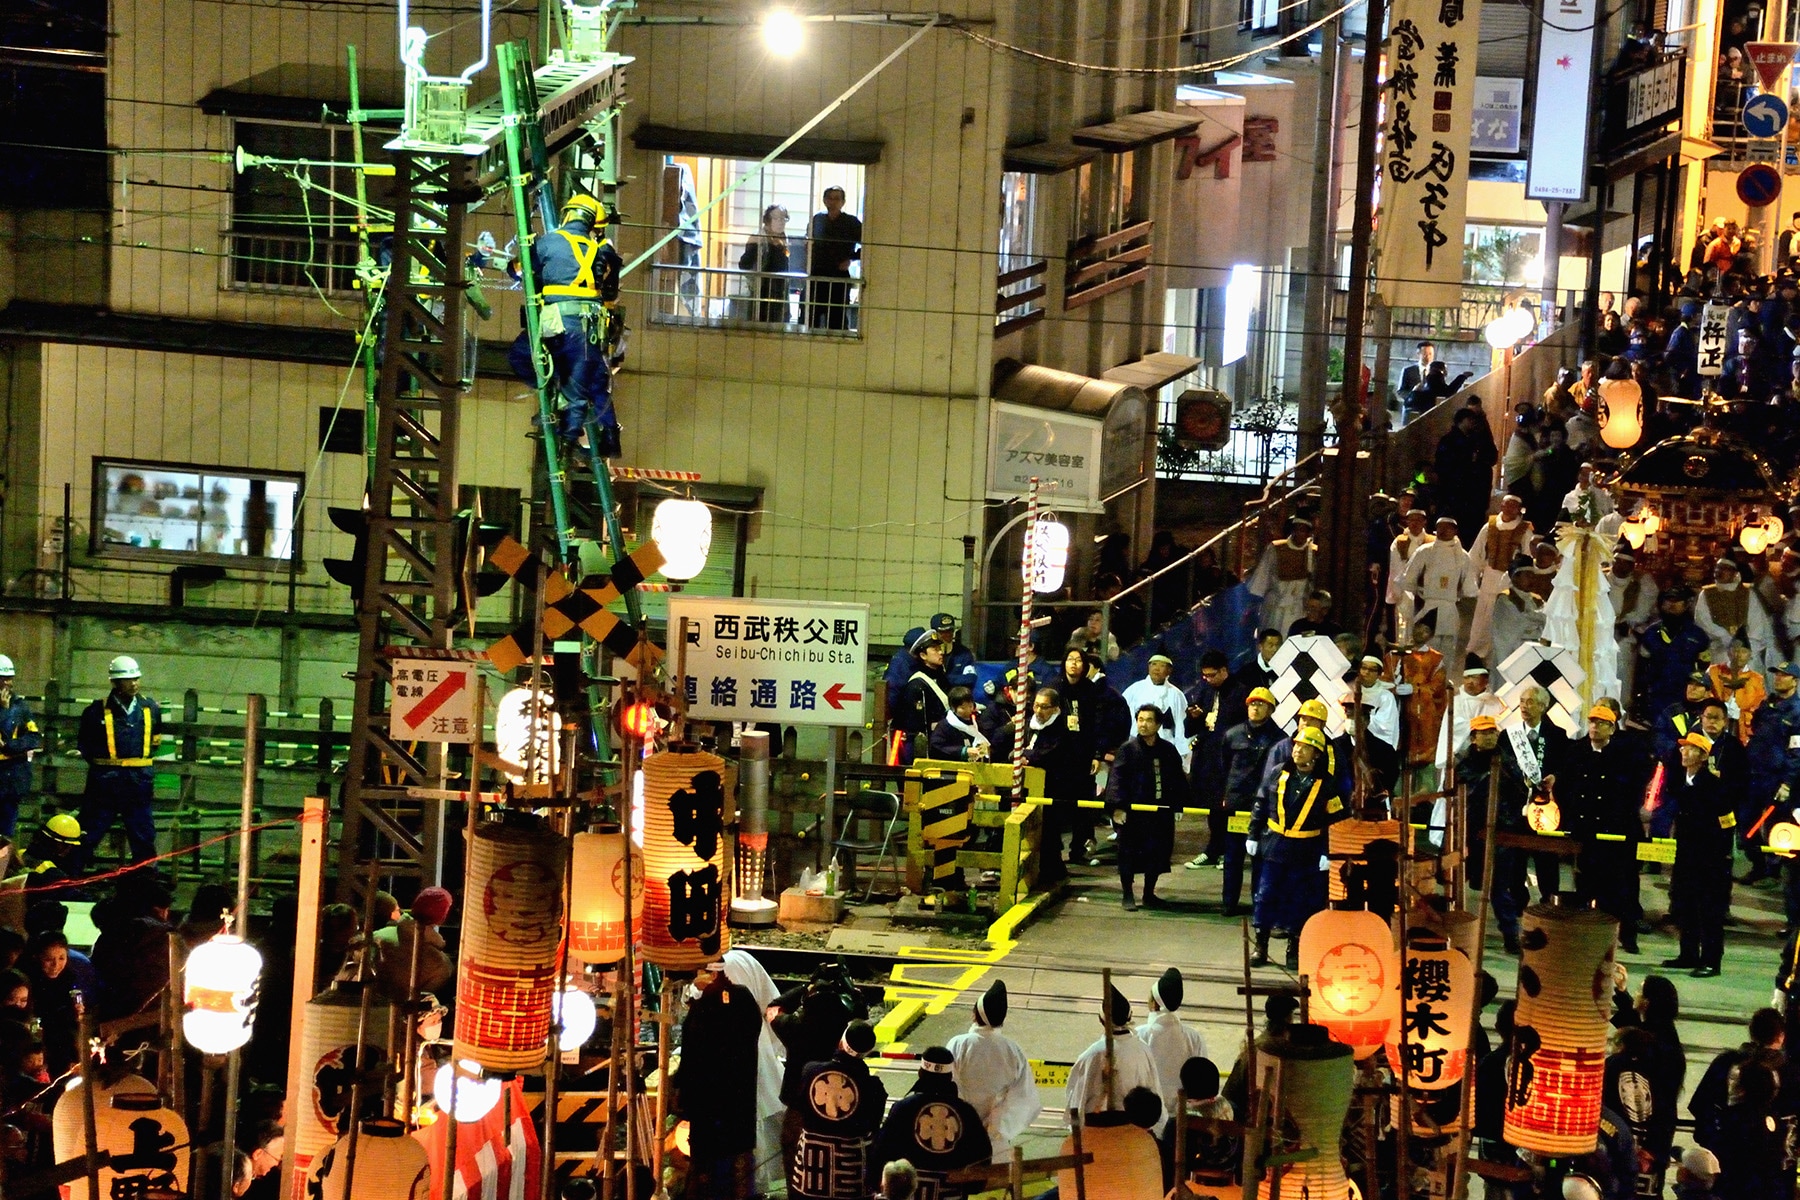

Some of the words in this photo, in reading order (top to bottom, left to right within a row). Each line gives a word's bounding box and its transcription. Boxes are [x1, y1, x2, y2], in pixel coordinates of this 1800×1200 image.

[1755, 52, 1786, 64] 止まれ
[713, 614, 859, 646] 西武秩父駅
[716, 645, 824, 663] Seibu-Chichibu
[828, 649, 855, 664] Sta.
[396, 669, 439, 683] 高電圧
[396, 684, 424, 698] 電線
[431, 716, 470, 735] 注意
